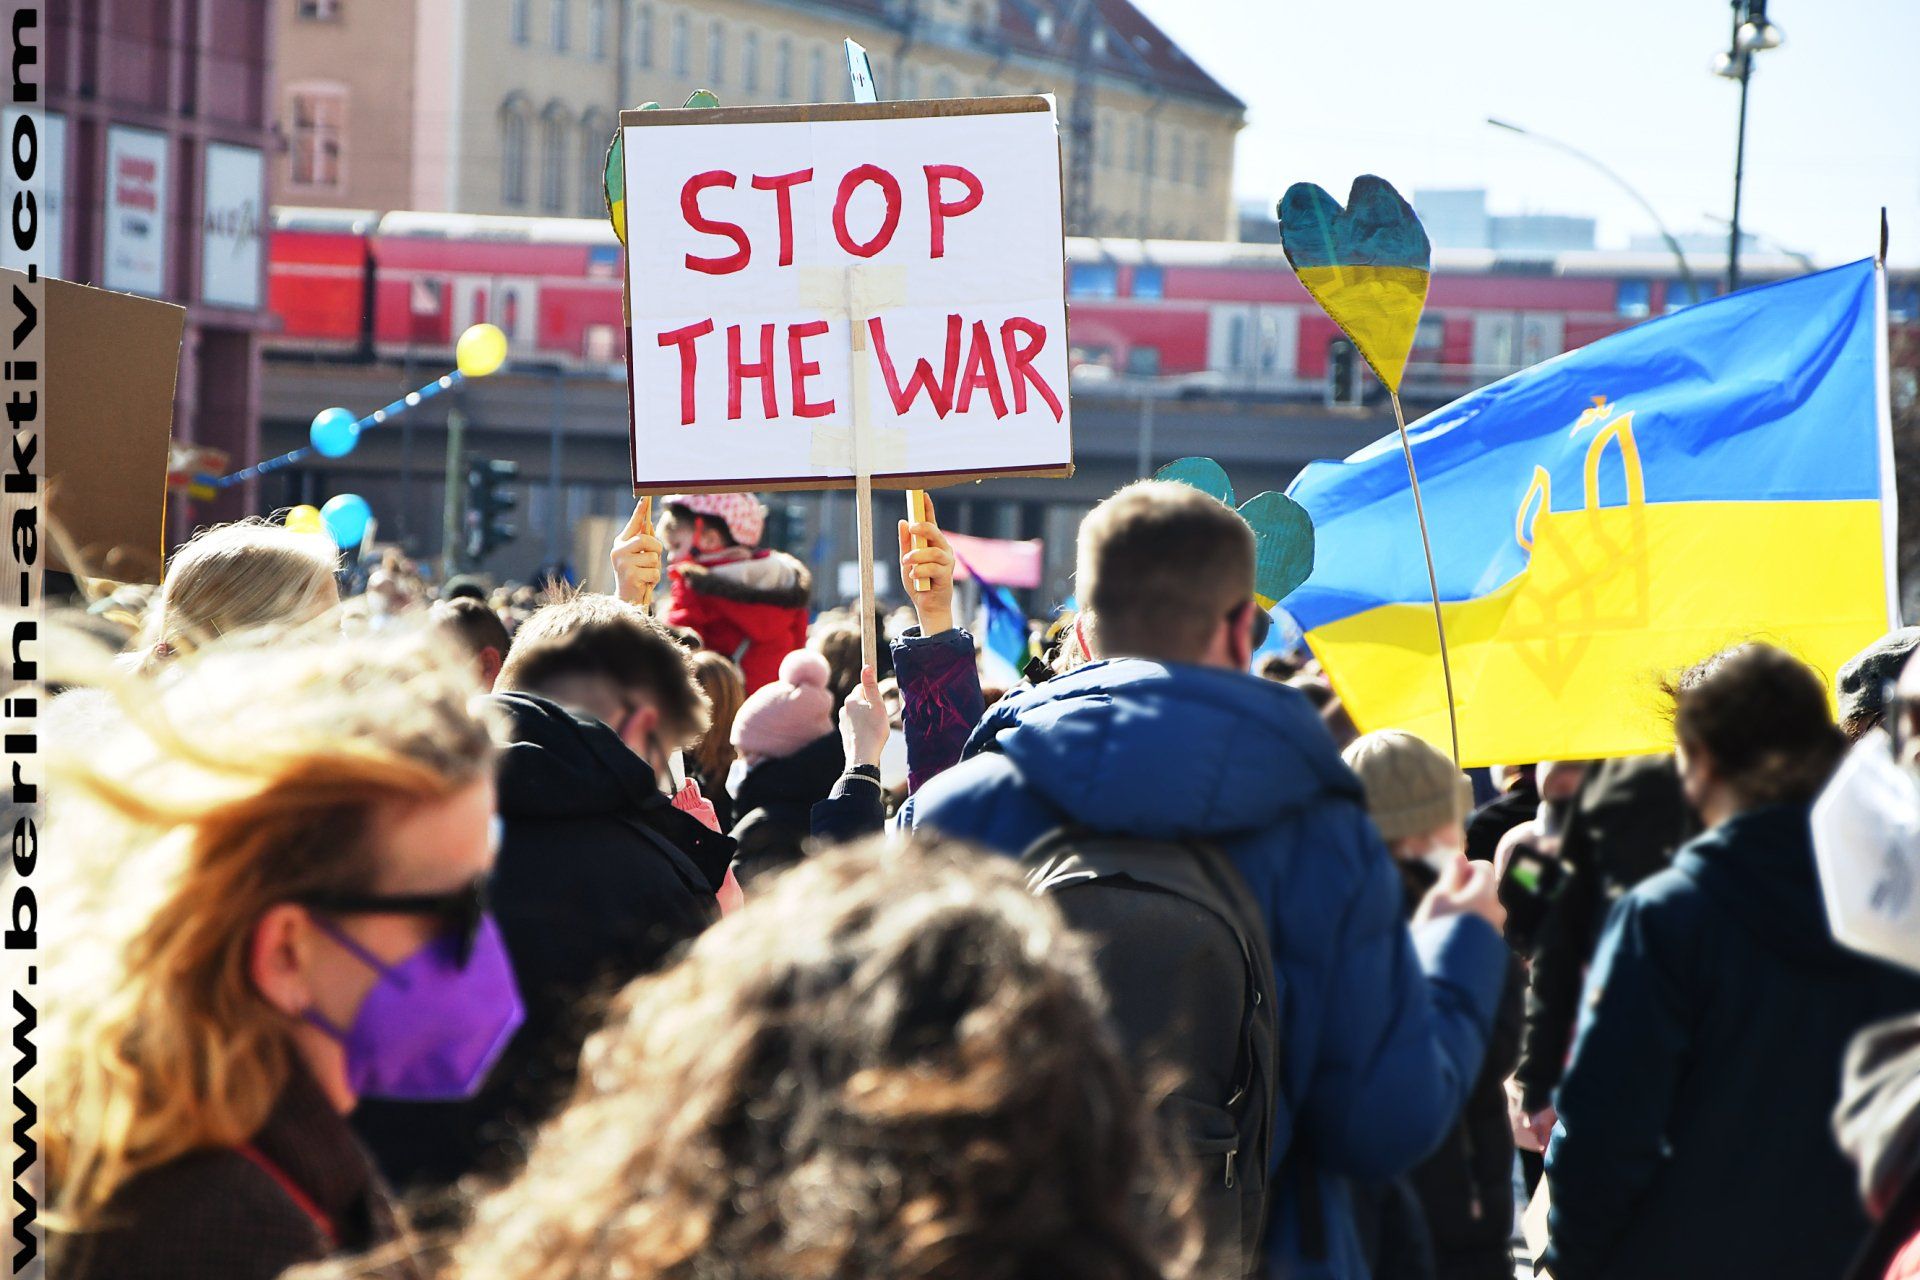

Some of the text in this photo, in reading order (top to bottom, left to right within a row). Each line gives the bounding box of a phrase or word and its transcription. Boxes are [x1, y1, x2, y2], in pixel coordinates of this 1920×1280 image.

[680, 163, 984, 275] STOP
[657, 314, 1064, 426] THE WAR
